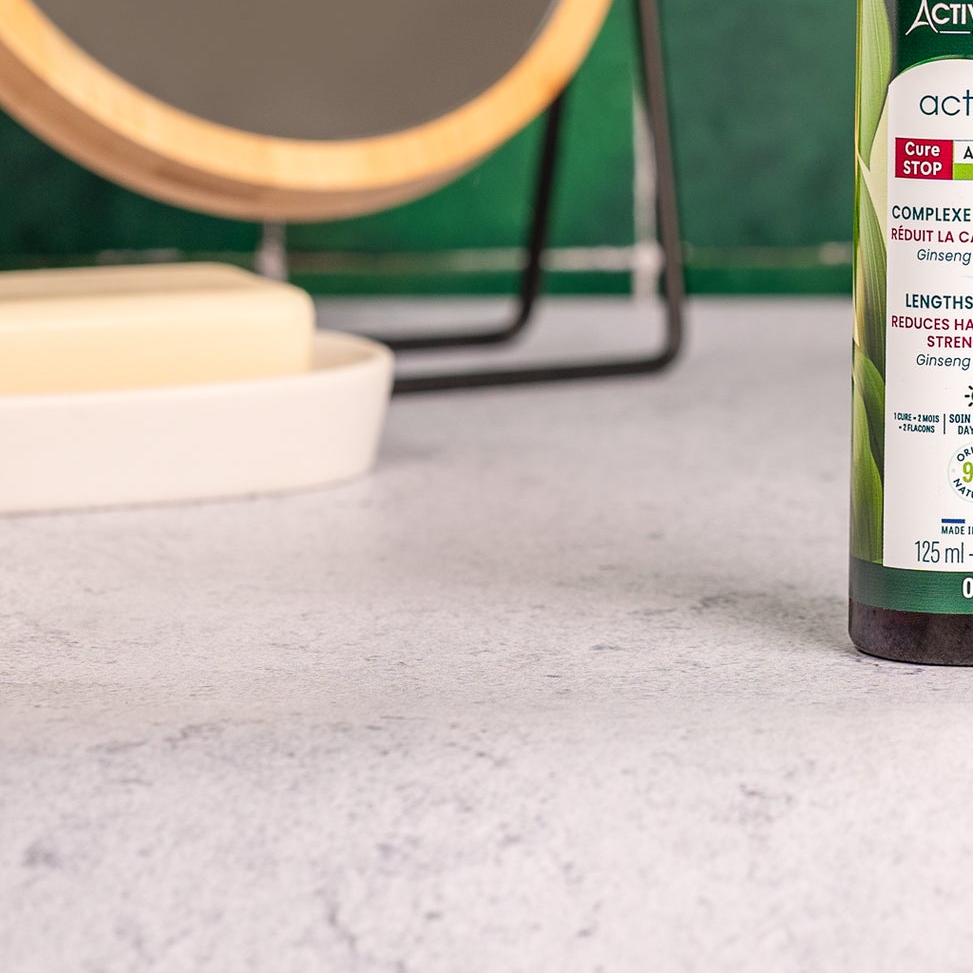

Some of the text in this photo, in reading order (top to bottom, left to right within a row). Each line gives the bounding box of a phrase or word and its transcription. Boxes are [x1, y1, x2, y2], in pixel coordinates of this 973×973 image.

[904, 141, 941, 157] Cure
[903, 160, 943, 176] STOP
[891, 205, 971, 222] COMPLEXE
[891, 225, 934, 242] RÉDUIT
[937, 230, 954, 243] LA
[916, 248, 972, 266] Ginseng
[905, 293, 973, 310] LENGTHS
[891, 315, 950, 331] REDUCES
[916, 354, 971, 371] Ginseng
[897, 412, 912, 421] CURE
[922, 414, 940, 423] MOIS
[949, 413, 971, 423] SOIN
[907, 424, 935, 433] FLACONS
[941, 526, 965, 535] MADE
[914, 540, 940, 563] 125
[945, 541, 964, 563] ml
